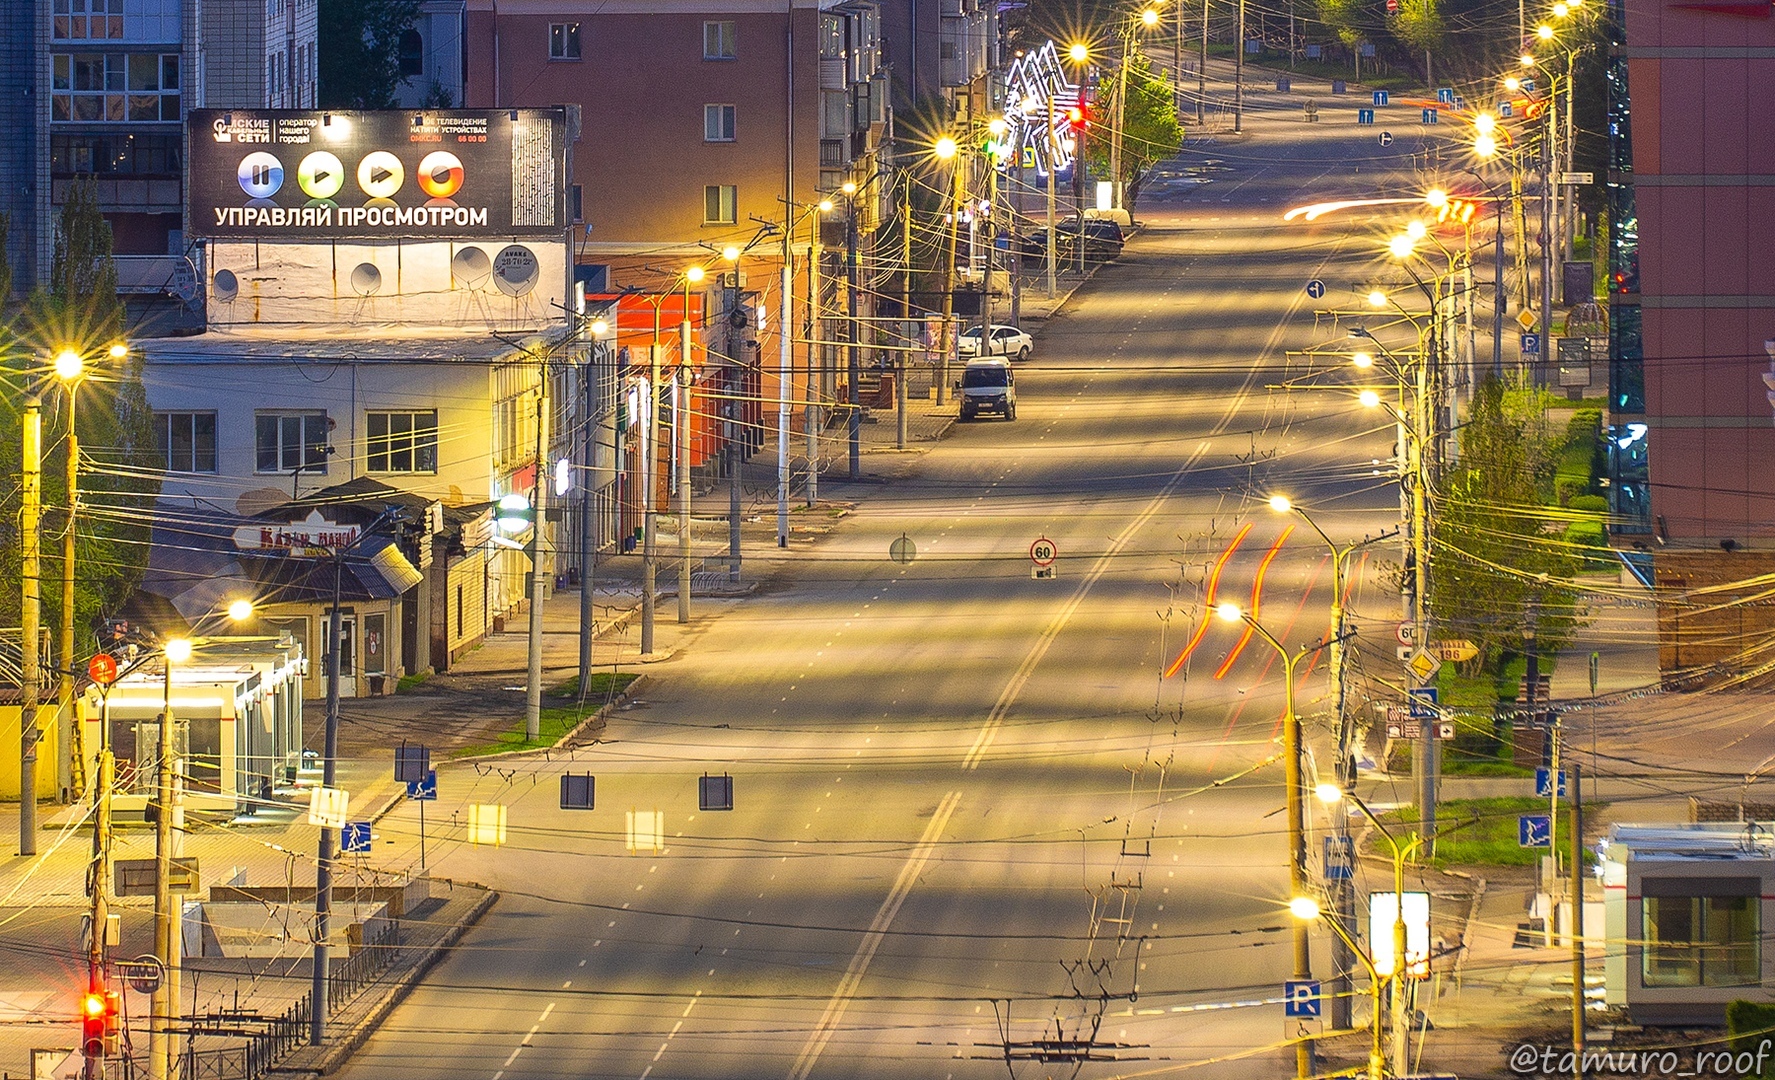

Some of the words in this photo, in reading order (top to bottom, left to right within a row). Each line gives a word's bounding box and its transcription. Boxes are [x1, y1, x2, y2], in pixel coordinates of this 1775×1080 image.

[279, 119, 317, 128] оператор
[411, 118, 435, 126] УНОЕ
[437, 118, 487, 126] ТЕЛЕВИДЕНИЕ
[279, 127, 309, 135] нашего
[441, 125, 487, 134] УСТРОЙСТВАХ
[237, 134, 270, 143] СЕТИ
[214, 204, 332, 227] УПРАВЛЯЙ
[338, 207, 488, 227] ПРОСМОТРОМ
[1035, 546, 1051, 559] 60
